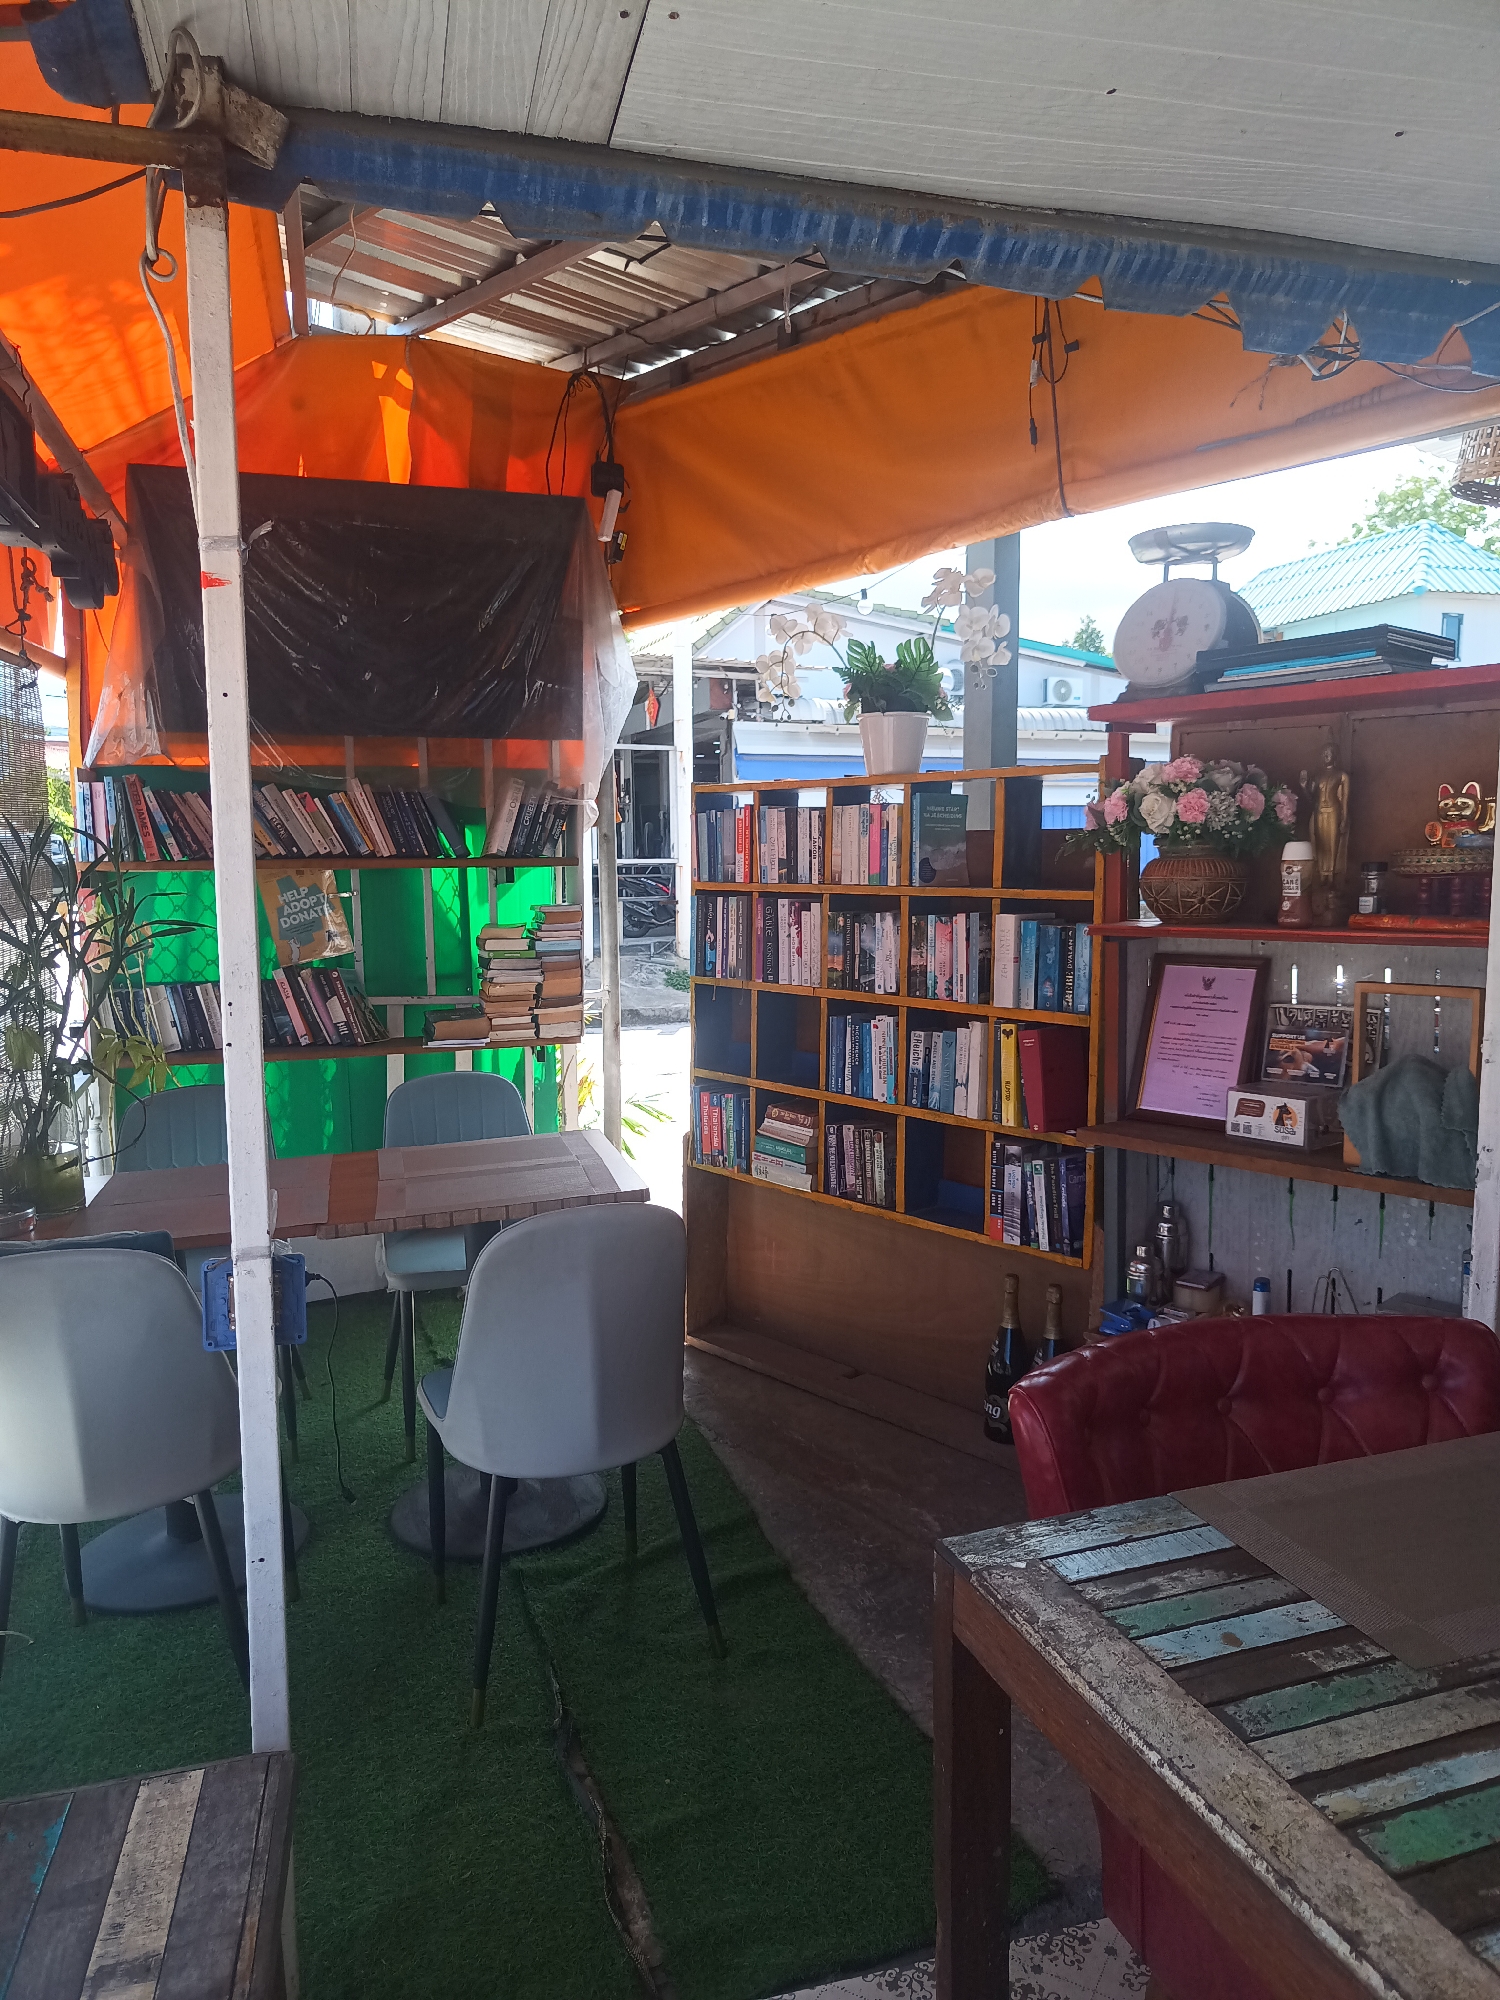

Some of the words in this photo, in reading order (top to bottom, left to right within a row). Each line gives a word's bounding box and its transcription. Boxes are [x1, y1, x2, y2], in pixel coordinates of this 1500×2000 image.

[136, 805, 151, 838] JAMES
[523, 795, 537, 826] CRUELTY
[277, 886, 309, 905] HELP
[283, 893, 326, 916] ADOPT
[279, 903, 333, 929] DONATE
[280, 981, 291, 999] KLASSE
[911, 1038, 923, 1067] Reichs
[711, 1107, 719, 1147] Thailandia
